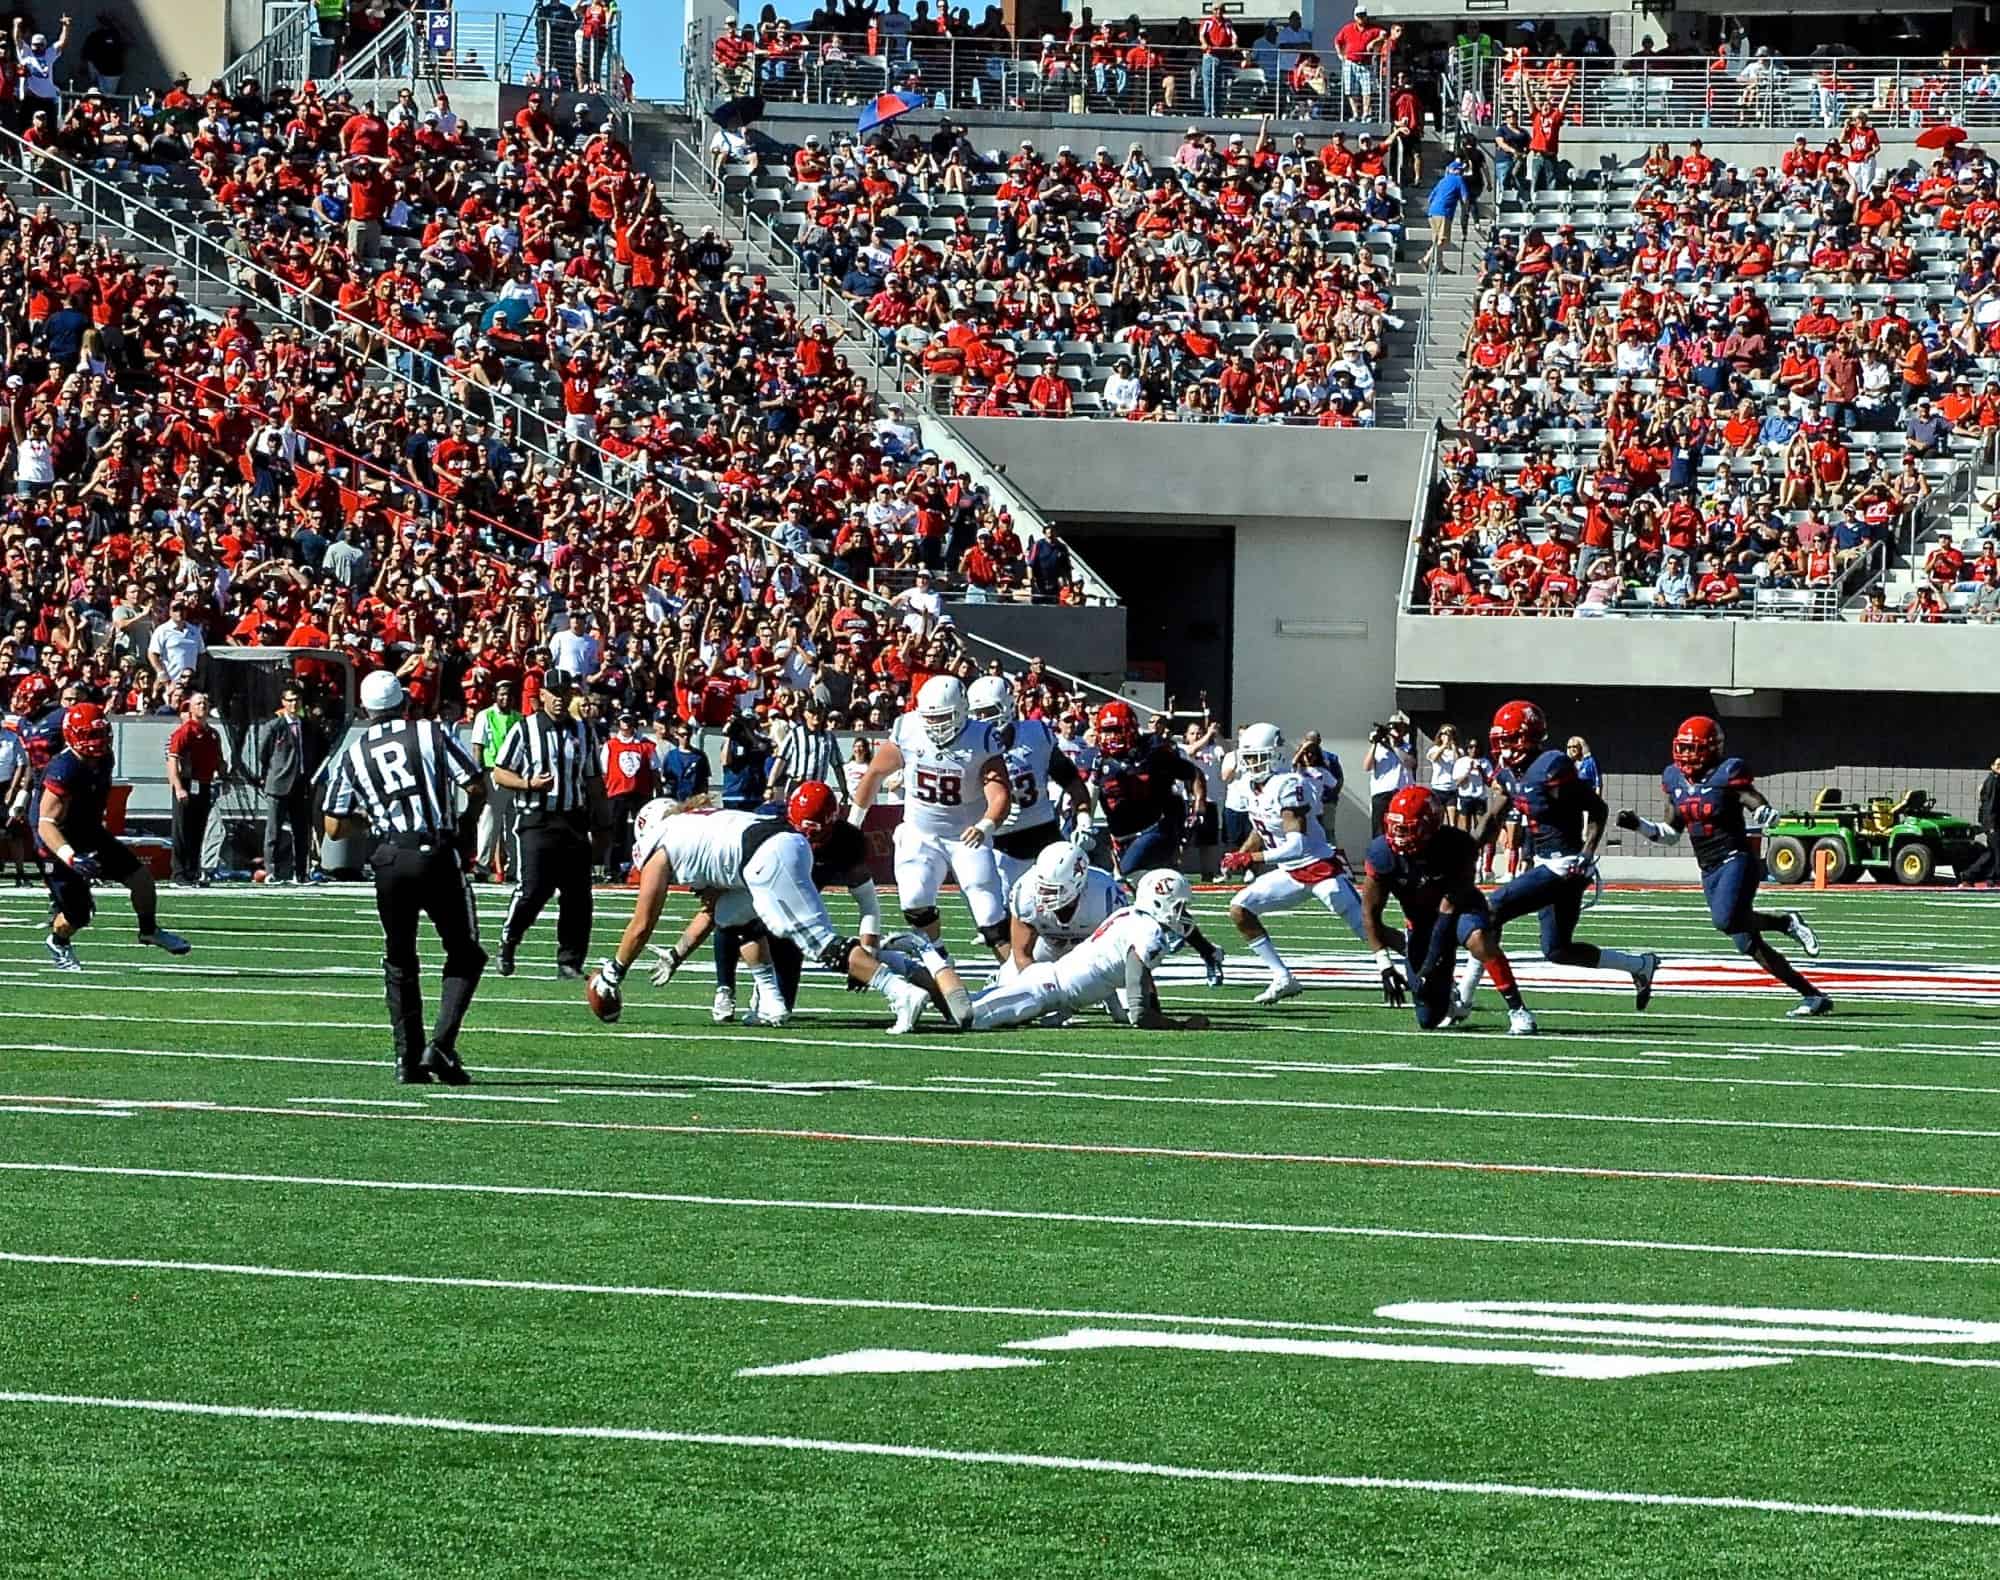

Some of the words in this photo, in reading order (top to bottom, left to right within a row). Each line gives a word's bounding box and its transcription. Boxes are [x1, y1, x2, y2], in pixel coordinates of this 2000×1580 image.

[432, 14, 449, 28] 26
[370, 741, 416, 794] R
[917, 771, 962, 806] 58
[1011, 772, 1039, 809] 3
